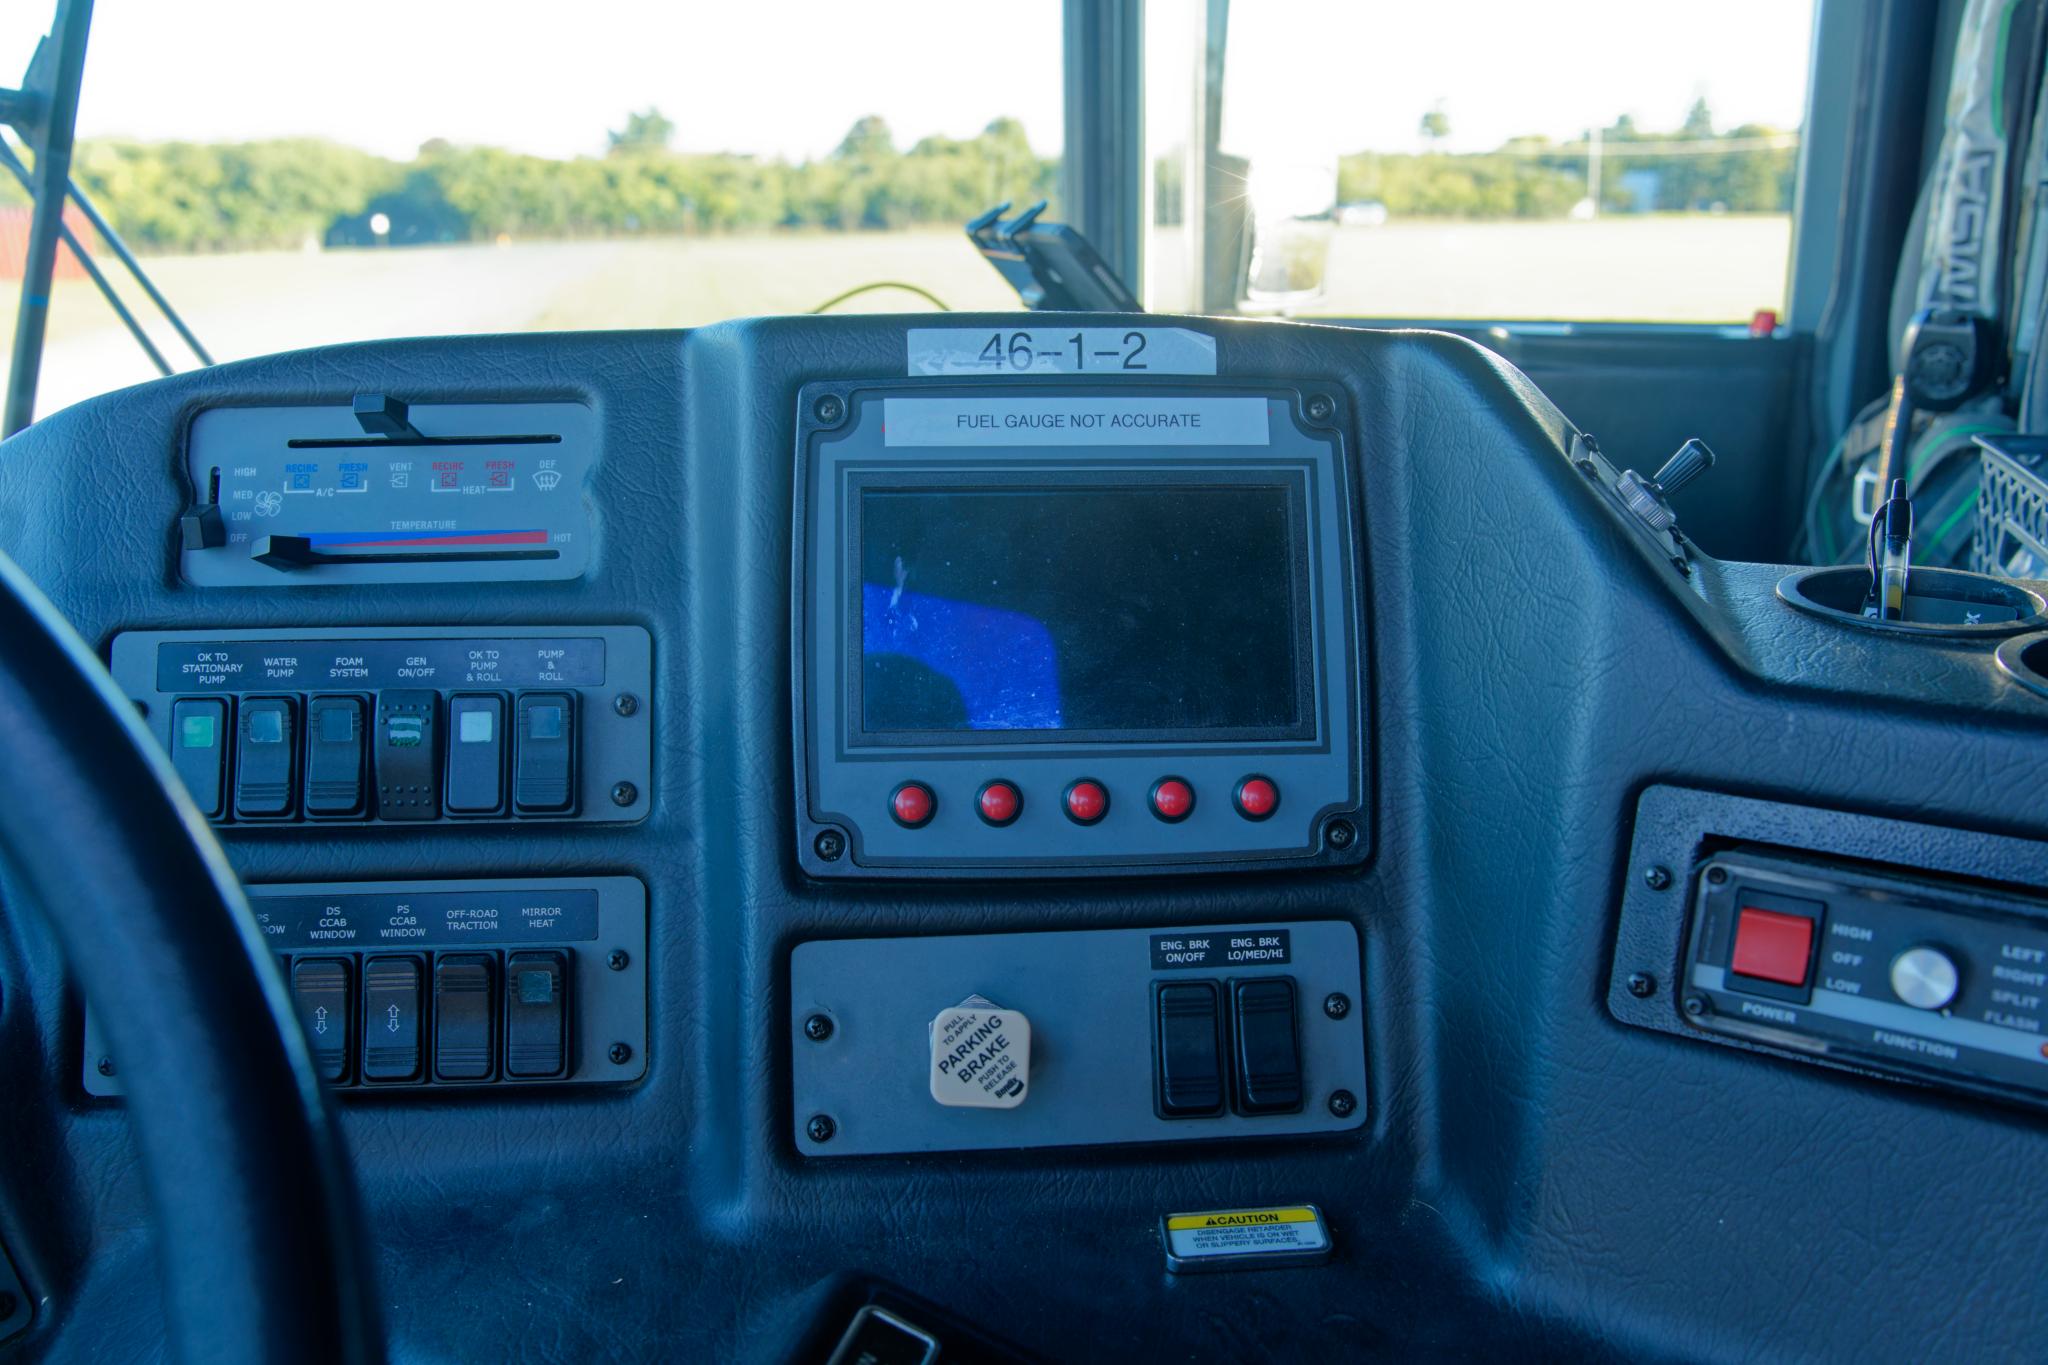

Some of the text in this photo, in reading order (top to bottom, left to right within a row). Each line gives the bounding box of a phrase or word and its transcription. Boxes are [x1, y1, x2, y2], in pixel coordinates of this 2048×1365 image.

[978, 331, 1148, 371] 46-1-2
[957, 413, 1201, 429] FUEL GAUGE NOT ACCURATE
[285, 463, 318, 473] RECIRC
[338, 463, 368, 472] FRESH
[389, 462, 413, 472] VENT
[432, 461, 464, 471] RECIRC
[486, 460, 515, 470] FRESH
[539, 459, 556, 469] DEF
[234, 467, 257, 477] HIGH
[232, 490, 253, 500] MED
[316, 488, 334, 497] A/C
[462, 485, 486, 495] HEAT
[231, 511, 251, 521] LOW
[391, 520, 457, 530] TEMPERATURE
[230, 533, 248, 543] OFF
[553, 533, 572, 543] HOT
[197, 652, 229, 662] OK TO
[468, 650, 499, 660] OK TO
[537, 649, 565, 659] PUMP
[263, 657, 298, 667] WATER
[335, 657, 363, 666] FOAM
[406, 657, 427, 666] GEN
[470, 661, 498, 671] PUMP
[547, 661, 555, 670] &
[182, 663, 243, 673] STATIONARY
[267, 668, 294, 678] PUMP
[329, 668, 369, 677] SYSTEM
[397, 668, 436, 678] ON/OFF
[199, 675, 226, 685] PUMP
[466, 672, 502, 682] & ROLL
[538, 672, 564, 681] ROLL
[326, 906, 341, 916] DS
[396, 904, 410, 914] PS
[446, 909, 498, 919] OFF-ROAD
[521, 907, 562, 917] MIRROR
[319, 918, 347, 928] CCAB
[389, 916, 417, 926] CCAB
[446, 921, 498, 931] TRACTION
[529, 919, 555, 928] HEAT
[310, 929, 356, 940] WINDOW
[380, 928, 427, 938] WINDOW
[1831, 923, 1873, 941] HIGH
[1160, 939, 1210, 951] ENG. BRK
[1230, 937, 1280, 948] ENG. BRK
[1165, 952, 1206, 963] ON/OFF
[1227, 949, 1284, 961] LO/MED/HI
[2001, 943, 2046, 963] LEFT
[1831, 951, 1863, 966] OFF
[1991, 965, 2048, 987] RIGHT
[1825, 976, 1861, 994] LOW
[1990, 989, 2041, 1010] SPLIT
[1741, 1001, 1797, 1025] POWER
[943, 1015, 965, 1033] PULL
[1983, 1010, 2040, 1033] FLASH
[942, 1014, 977, 1046] TO APPLY
[938, 1015, 1003, 1075] PARKING
[1872, 1030, 1959, 1060] FUNCTION
[957, 1034, 1010, 1083] BRAKE
[977, 1054, 1010, 1084] PUSH TO
[983, 1061, 1018, 1092] RELEASE
[1217, 1213, 1279, 1225] CAUTION
[1197, 1224, 1292, 1236] DISENGAGE RETARDER
[1192, 1235, 1218, 1243] WHEN
[1219, 1233, 1255, 1241] VEHICLE
[1210, 1239, 1250, 1248] SLIPPERY
